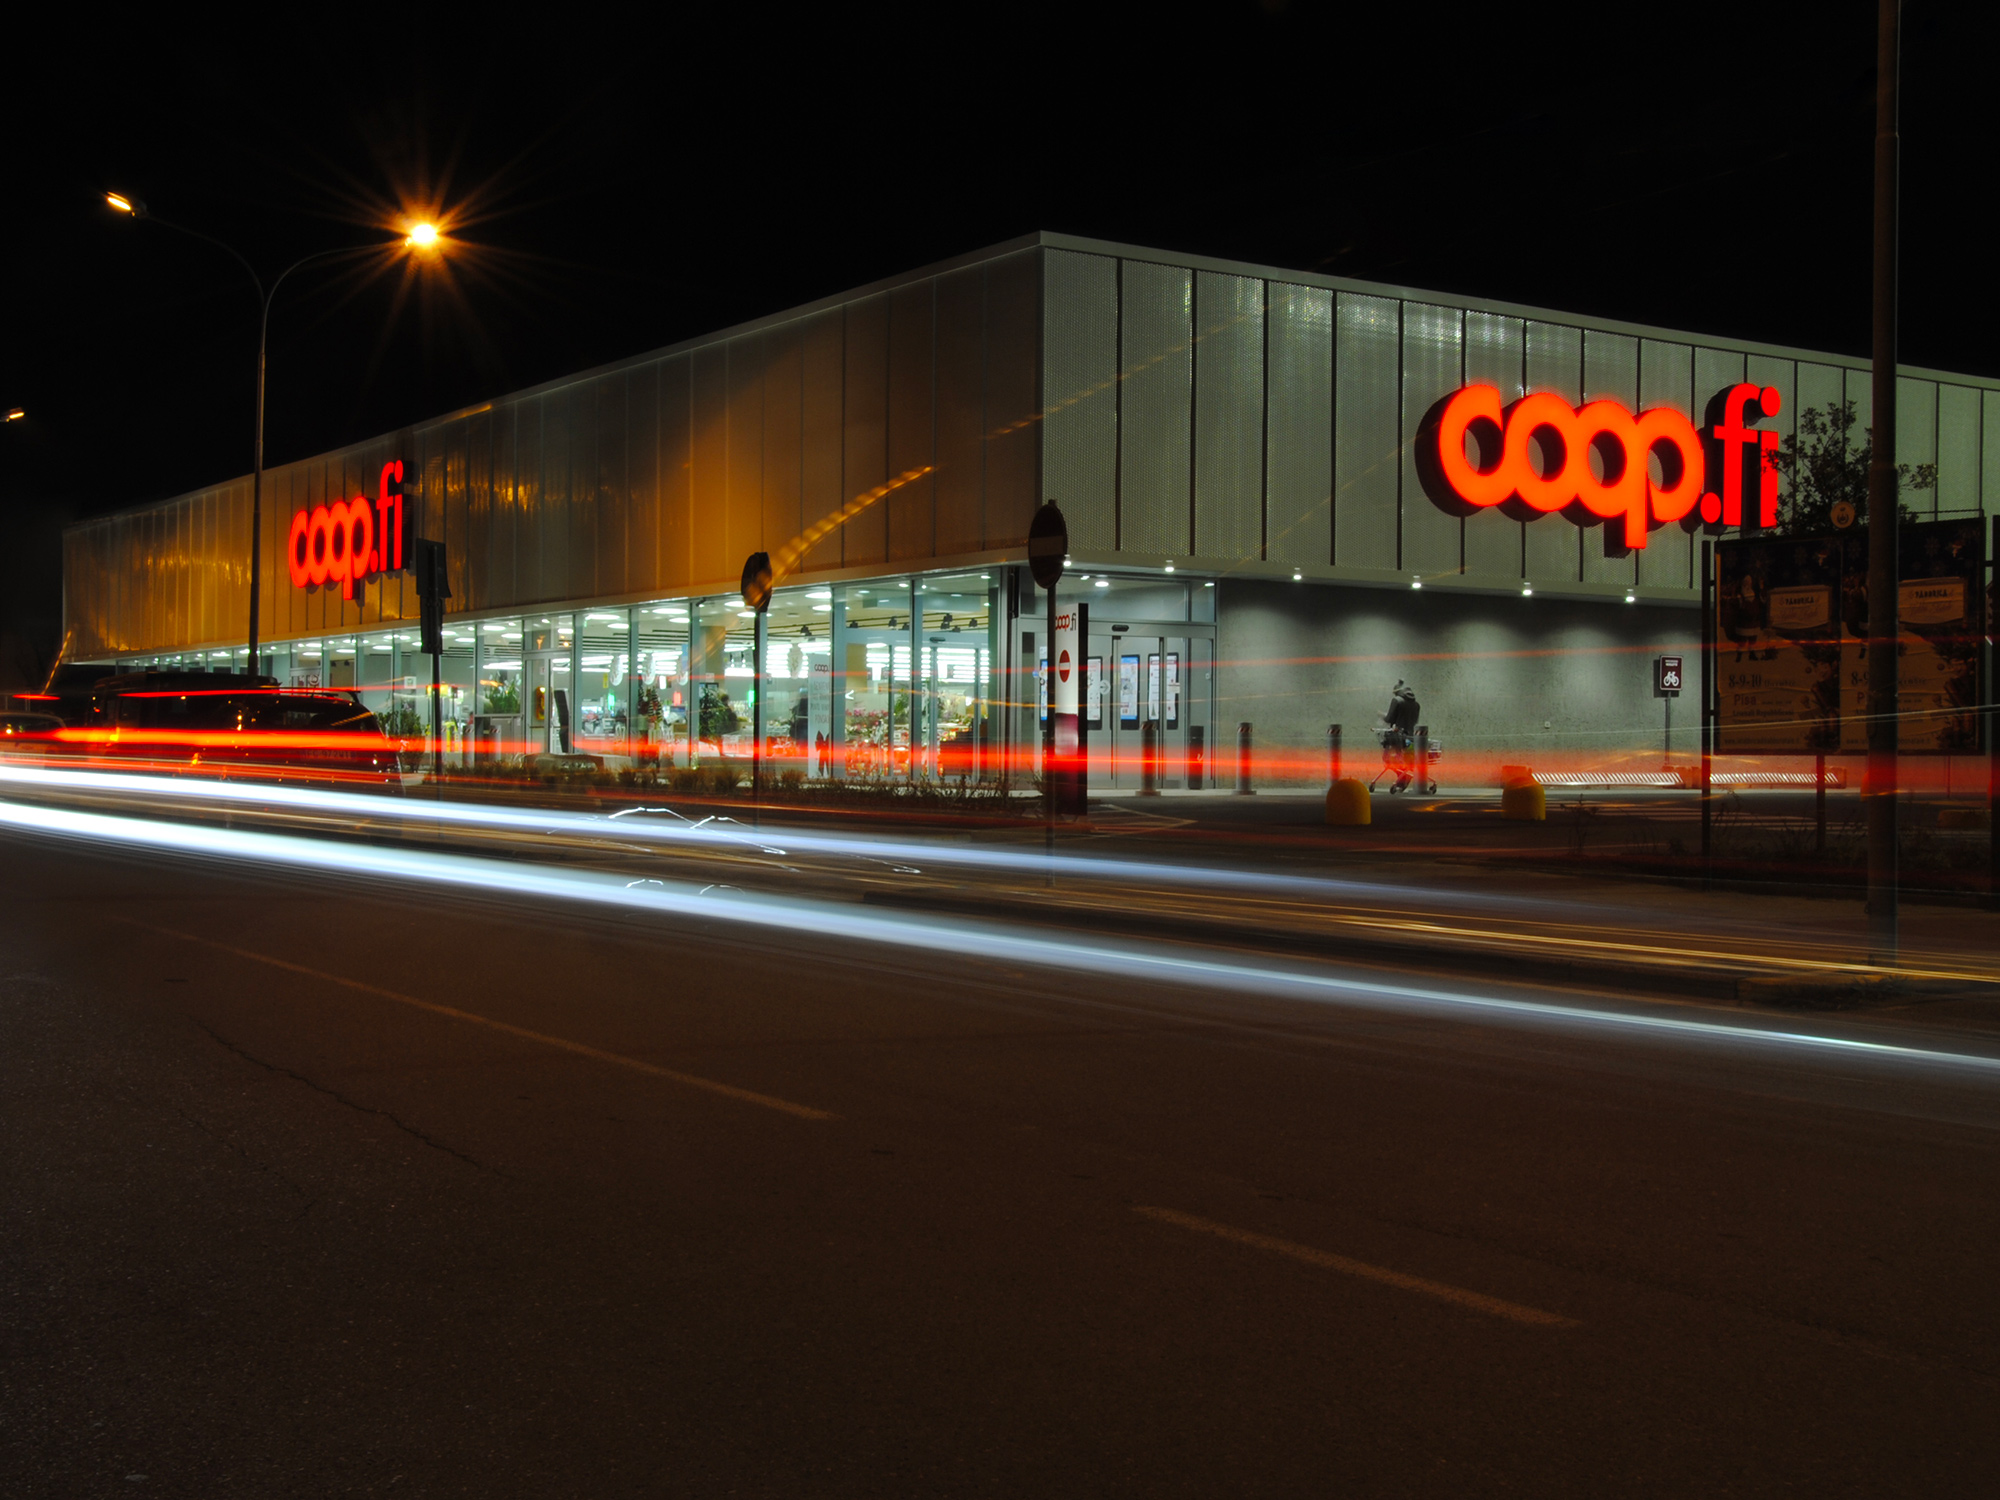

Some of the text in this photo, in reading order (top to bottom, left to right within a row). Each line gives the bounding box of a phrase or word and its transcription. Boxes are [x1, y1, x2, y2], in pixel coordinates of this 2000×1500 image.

[288, 459, 404, 600] coop.fi
[1439, 382, 1781, 549] coop.fi
[1733, 694, 1757, 706] Pisa
